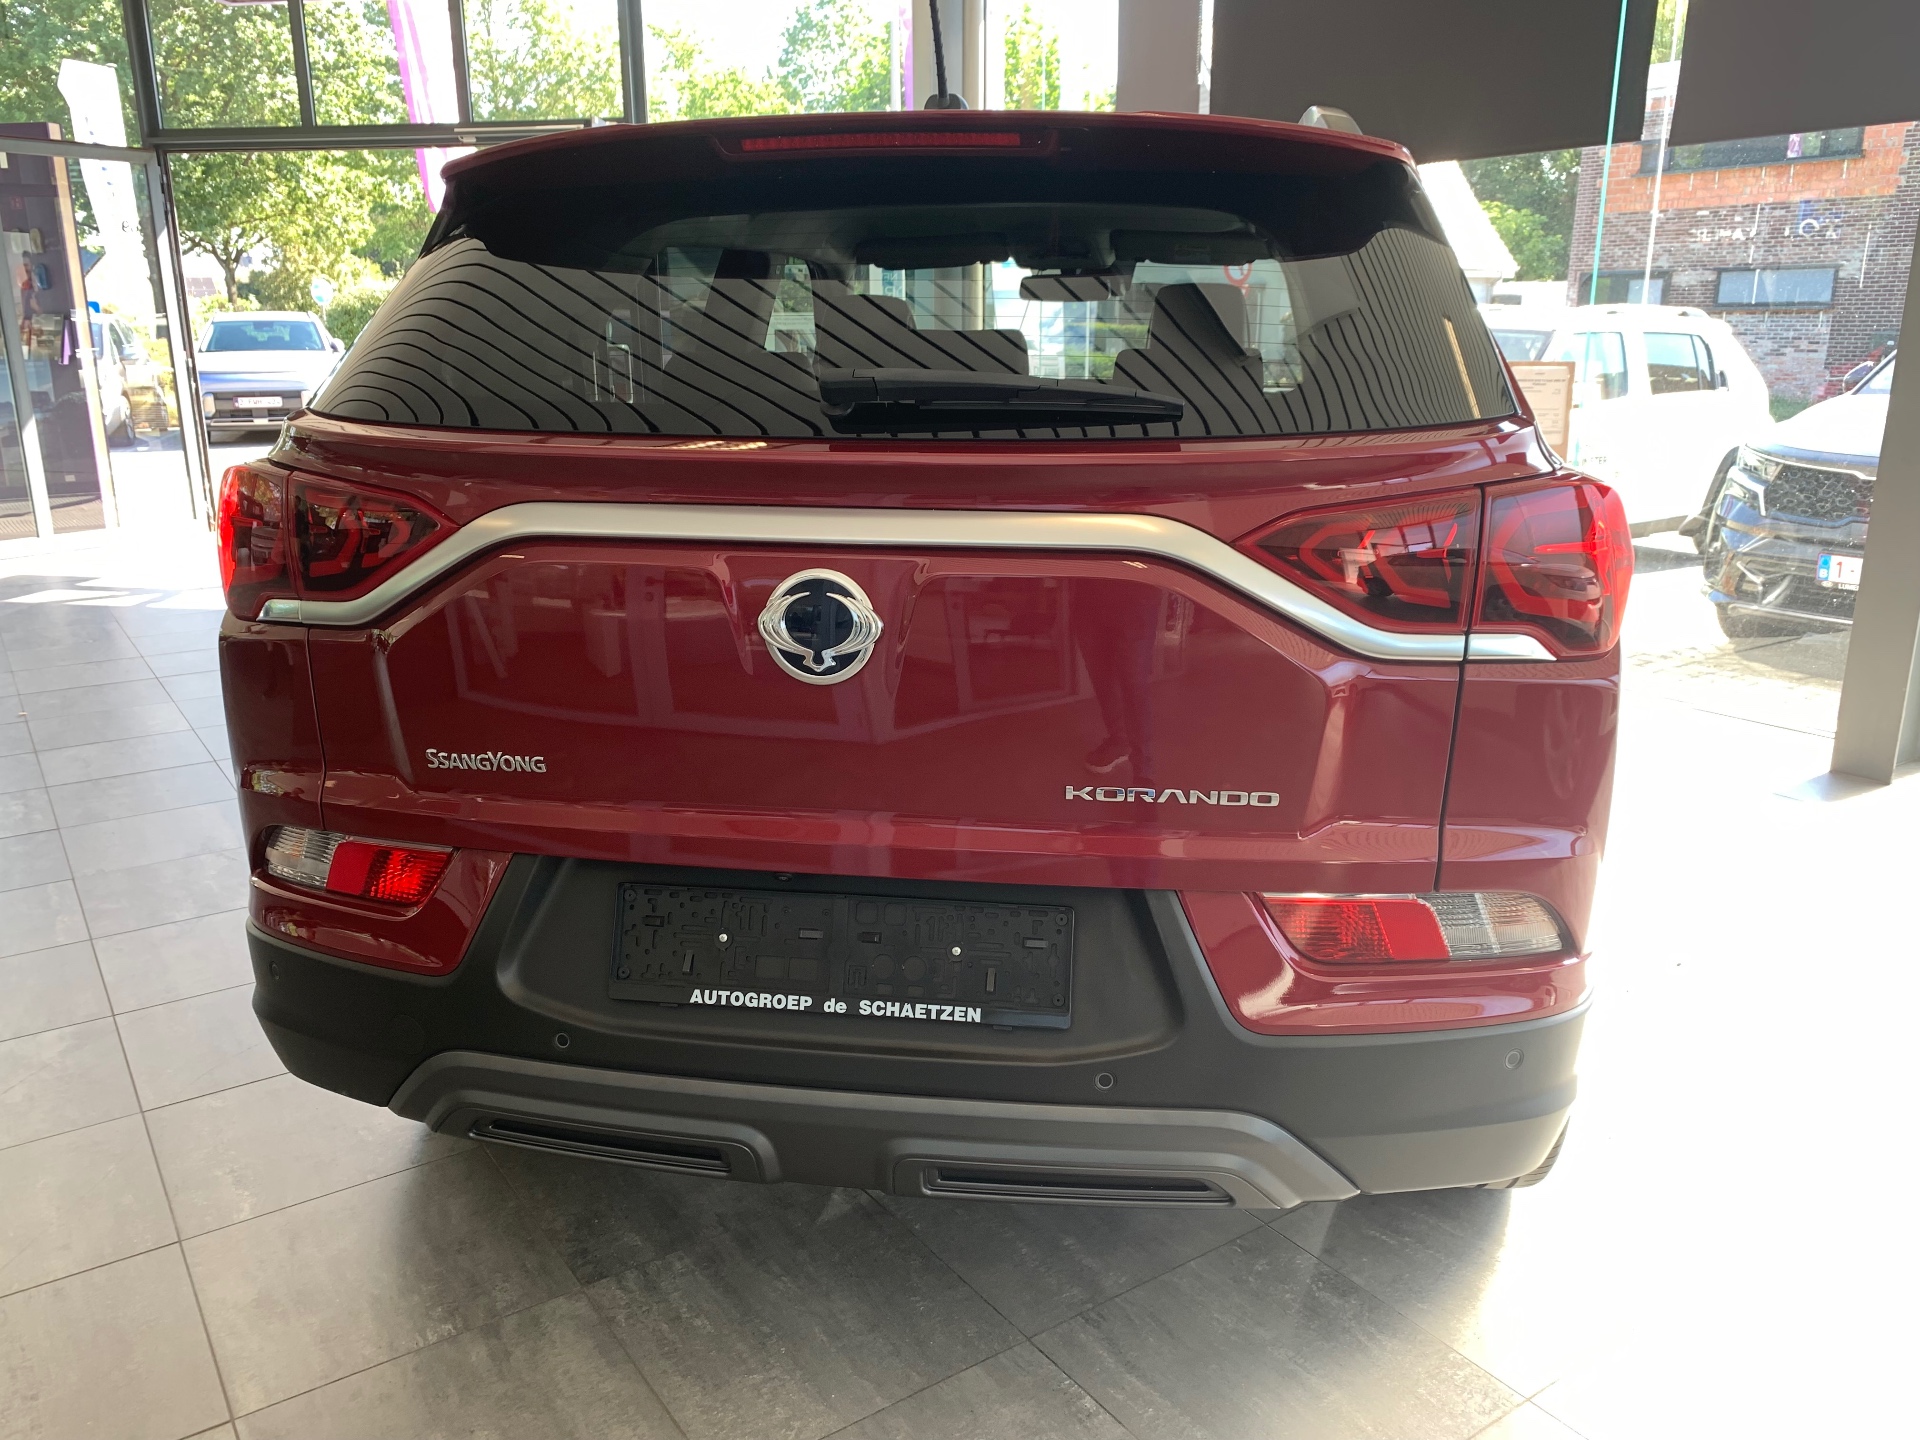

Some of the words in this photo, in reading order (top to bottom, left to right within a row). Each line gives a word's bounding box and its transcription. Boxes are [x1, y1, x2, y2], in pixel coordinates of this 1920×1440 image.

[1065, 785, 1280, 808] KORANDO
[689, 988, 813, 1011] AUTOGROEP
[823, 998, 848, 1014] de
[858, 1000, 982, 1023] SCHAETZEN
